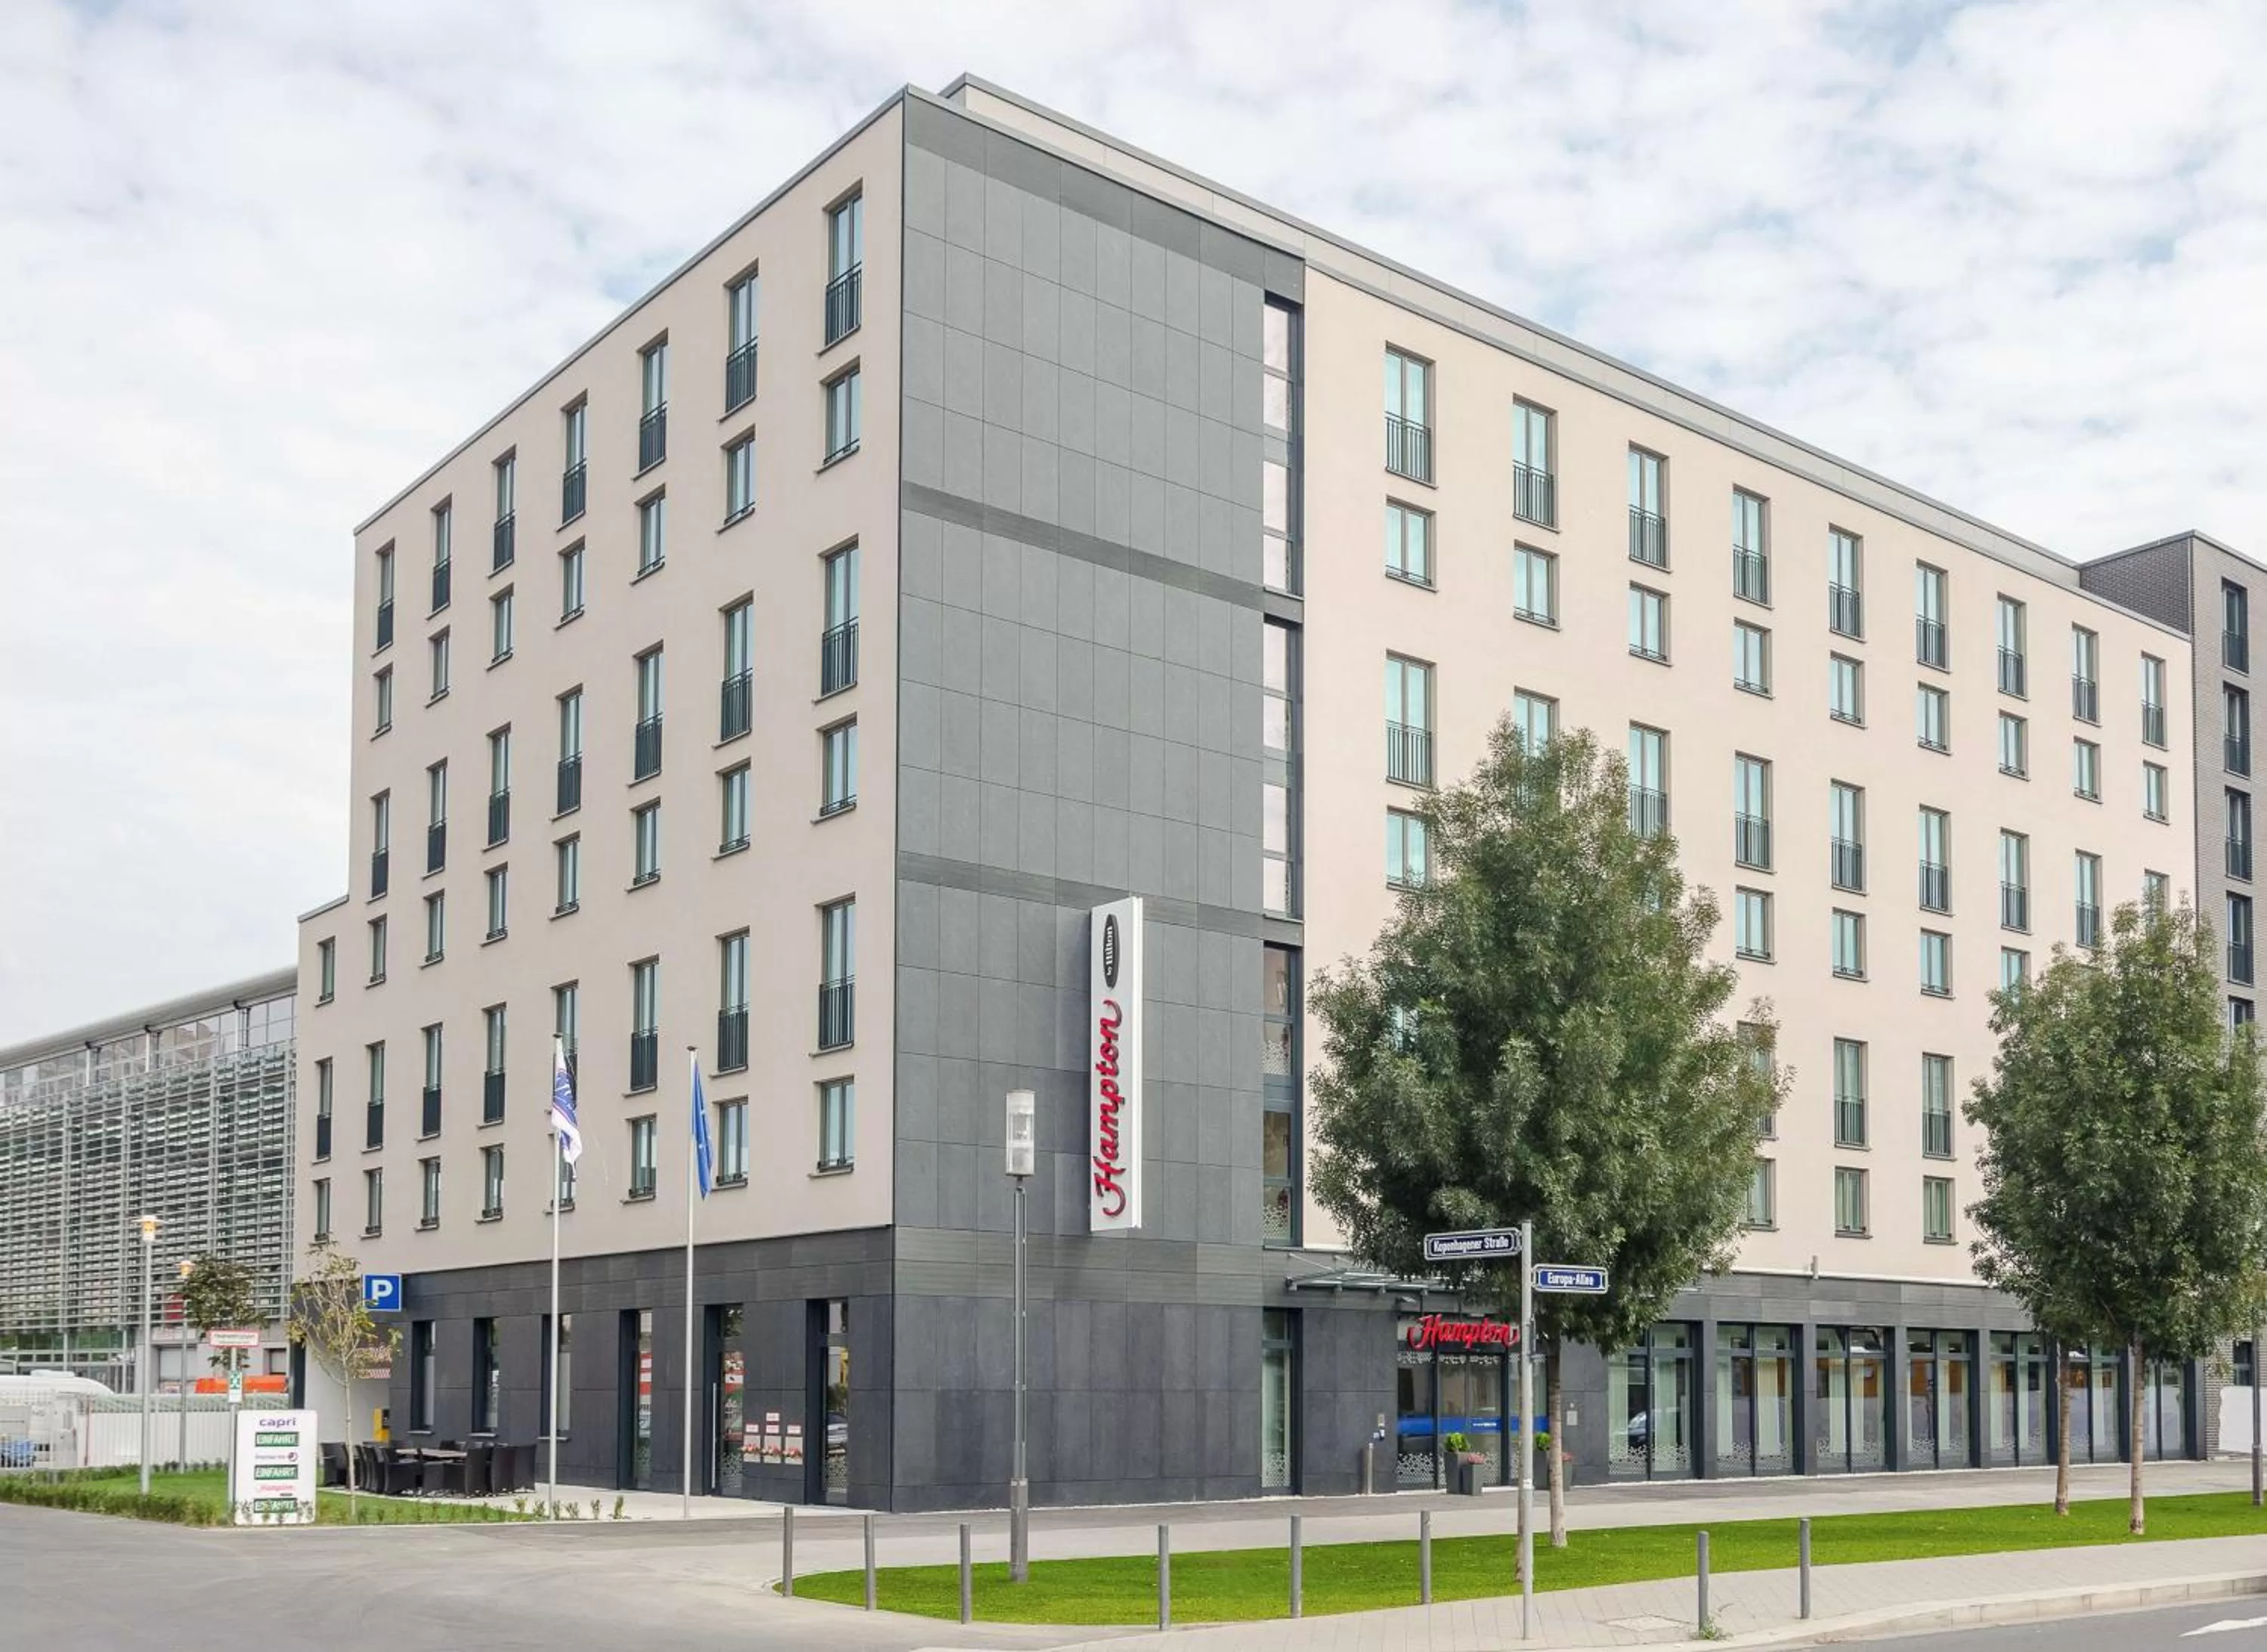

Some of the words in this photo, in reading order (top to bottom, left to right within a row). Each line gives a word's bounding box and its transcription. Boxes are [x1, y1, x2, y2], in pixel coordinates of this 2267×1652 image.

[1105, 926, 1113, 965] Hilton
[1093, 999, 1127, 1217] Hampton
[1484, 1236, 1509, 1249] Straße
[372, 1279, 393, 1304] P
[1547, 1273, 1594, 1287] Europa-Allee
[1407, 1313, 1520, 1350] Hampton
[259, 1417, 296, 1428] capri
